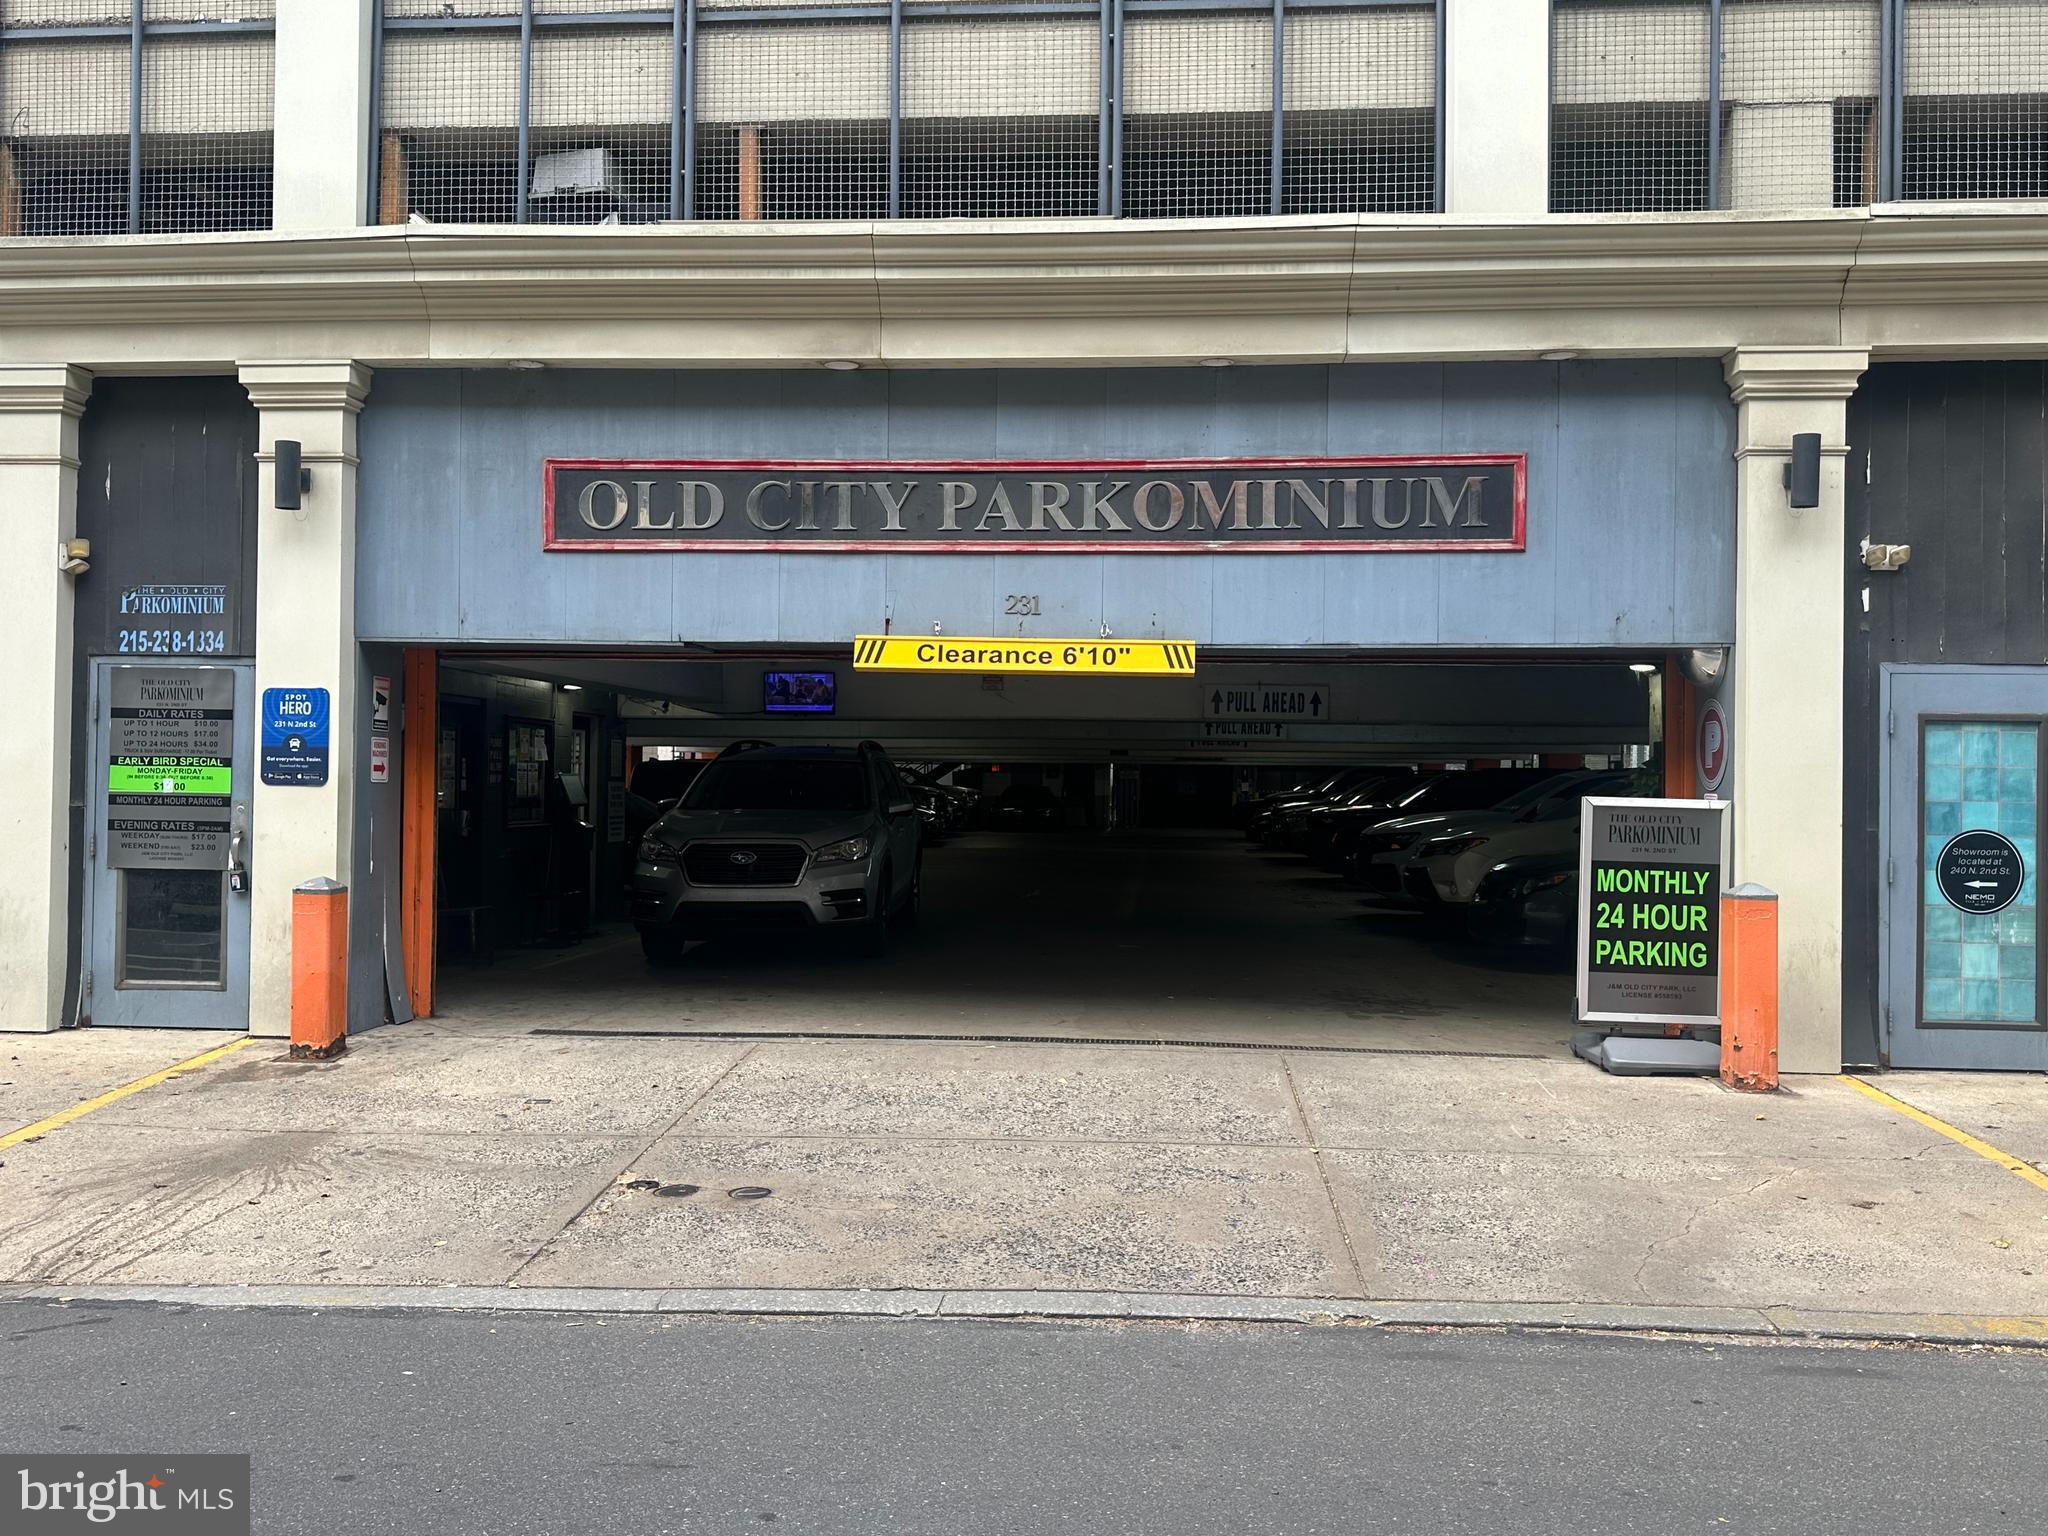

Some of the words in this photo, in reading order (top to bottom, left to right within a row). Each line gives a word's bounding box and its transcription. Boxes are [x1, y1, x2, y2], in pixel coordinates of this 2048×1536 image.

[578, 480, 725, 531] OLD
[746, 480, 919, 531] CITY
[937, 476, 1489, 531] PARKOMINIUM
[202, 586, 225, 595] CITY
[119, 591, 225, 614] PARKOMINIUM
[1004, 595, 1041, 615] 231
[119, 630, 225, 652] 215-238-1334
[917, 643, 1053, 664] Clearance
[1063, 646, 1130, 666] 6'10"
[140, 687, 204, 701] PARKOMINIUM
[280, 701, 312, 715] HERO
[1226, 691, 1256, 713] PULL
[1262, 691, 1305, 713] AHEAD
[138, 709, 168, 718] DAILY
[171, 710, 204, 719] RATES
[1215, 722, 1237, 735] PULL
[118, 757, 150, 765] EARLY
[152, 757, 177, 766] BIRD
[179, 757, 223, 766] SPECIAL
[137, 767, 203, 775] MONDAY-FRIDAY
[116, 796, 152, 804] MONTHLY
[154, 796, 162, 804] 24
[164, 797, 186, 805] HOUR
[188, 798, 223, 806] PARKING
[114, 821, 159, 830] EVENING
[161, 822, 195, 831] RATES
[1609, 814, 1631, 824] THE
[1634, 814, 1656, 824] OLD
[1659, 815, 1683, 825] CITY
[1608, 825, 1700, 846] PARKOMINIUM
[1952, 847, 2000, 855] Showroom
[1950, 867, 1967, 875] 240
[1979, 867, 1997, 875] 2nd
[1597, 868, 1710, 895] MONTHLY
[1596, 903, 1625, 929] 24
[1632, 903, 1708, 931] HOUR
[1595, 940, 1708, 968] PARKING
